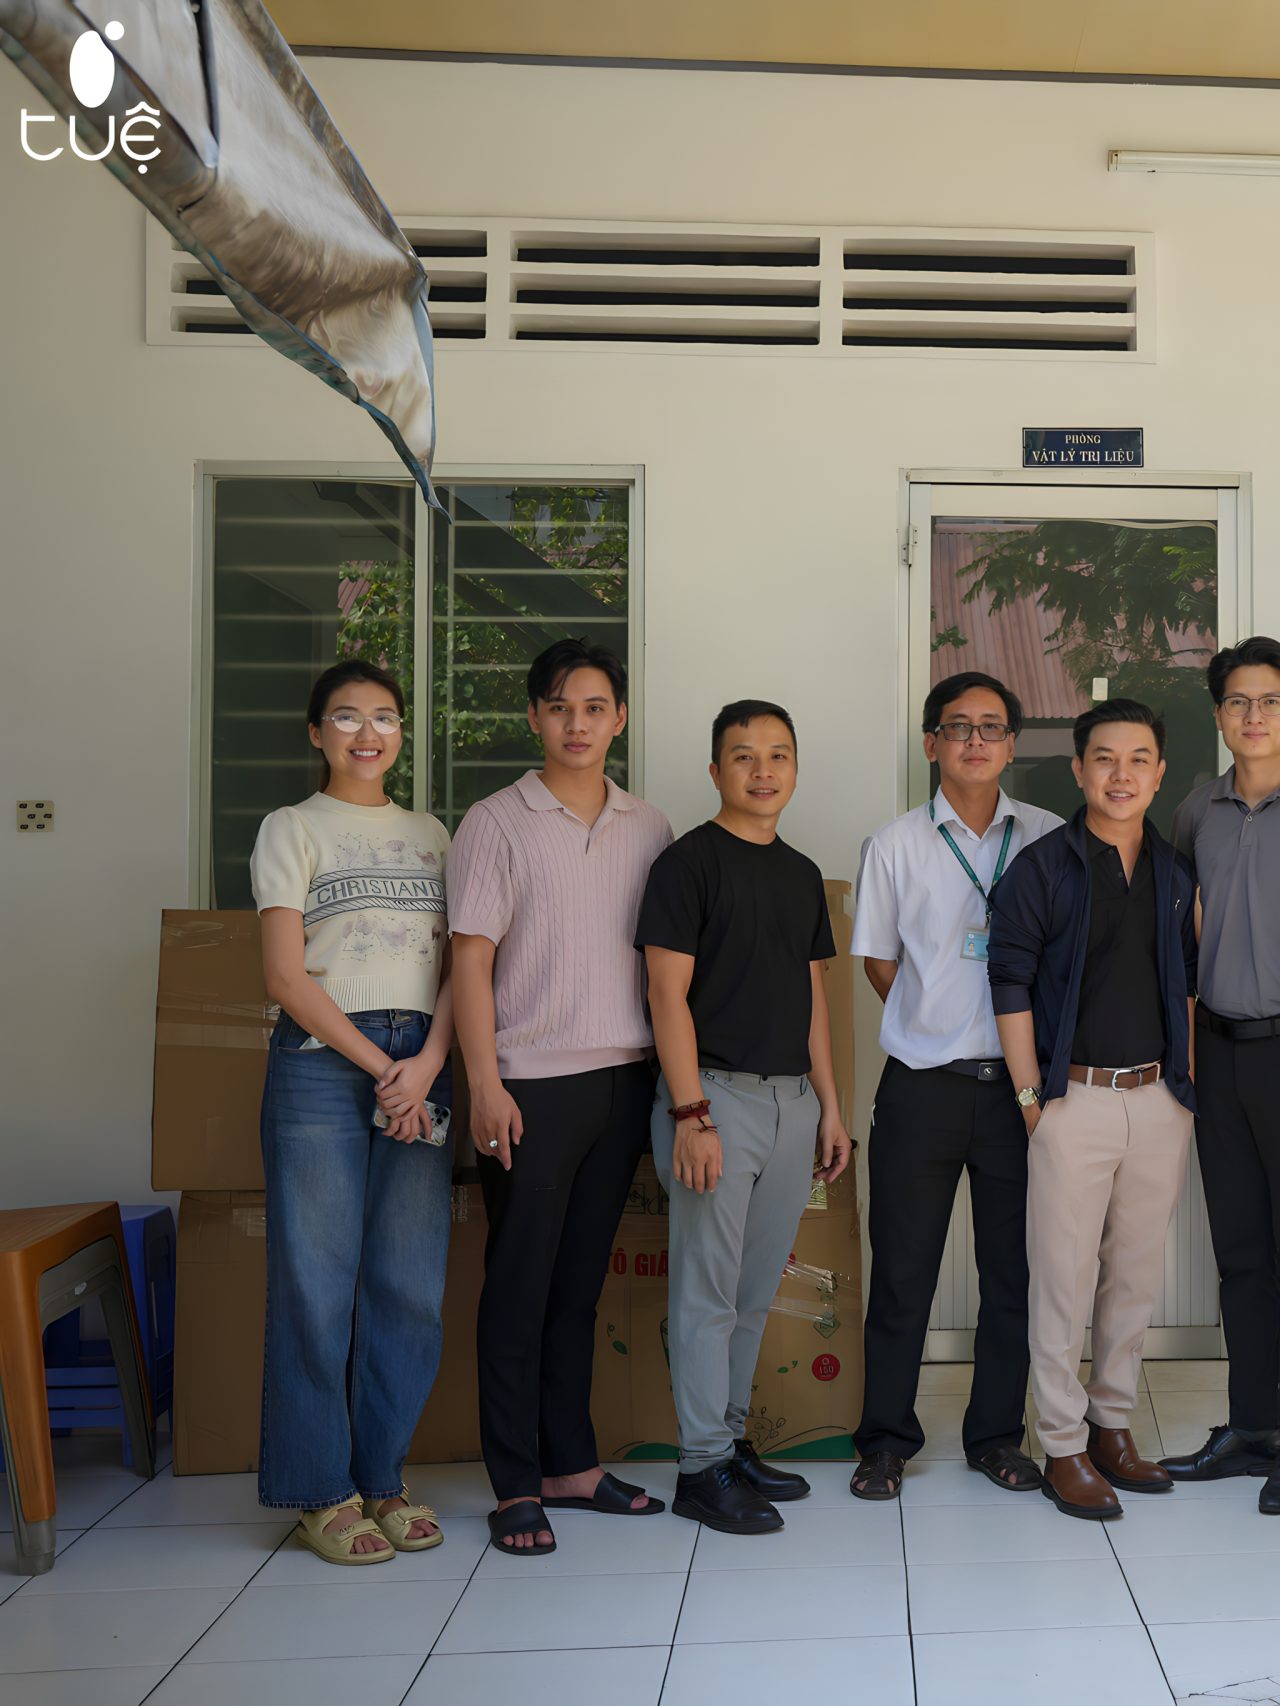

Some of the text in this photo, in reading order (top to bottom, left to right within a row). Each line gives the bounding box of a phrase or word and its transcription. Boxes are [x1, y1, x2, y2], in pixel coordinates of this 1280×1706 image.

[1065, 433, 1101, 444] PHÒNG
[1032, 447, 1135, 464] VẬT LÝ TRỊ LIỆU
